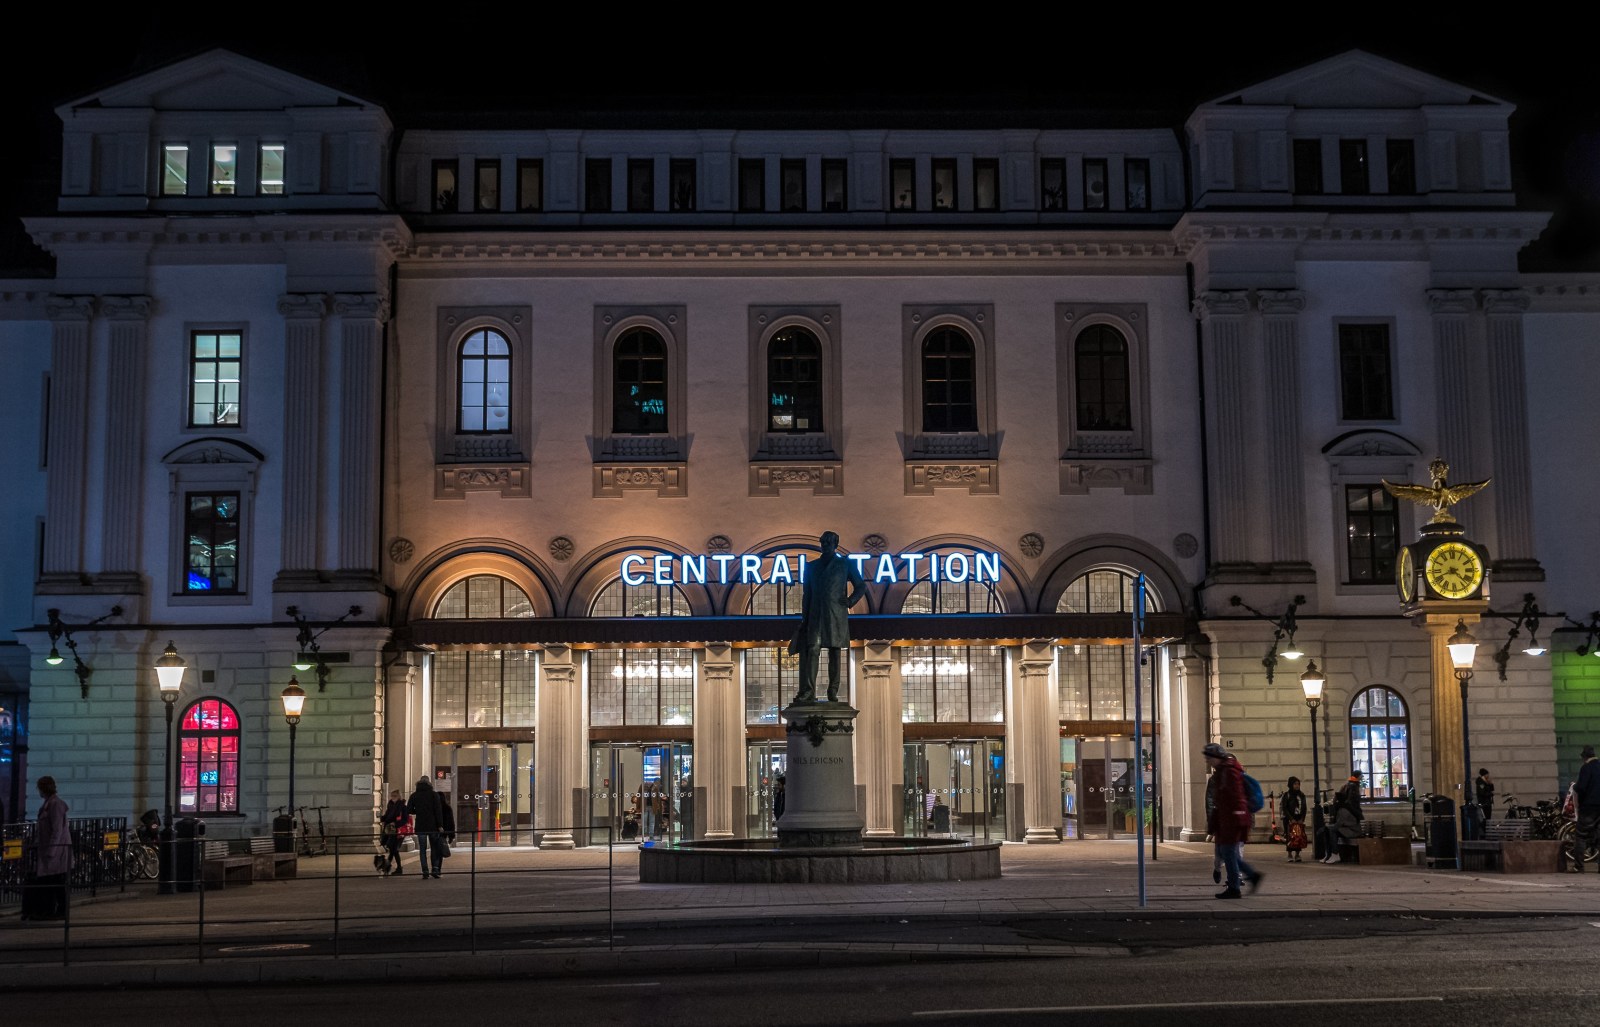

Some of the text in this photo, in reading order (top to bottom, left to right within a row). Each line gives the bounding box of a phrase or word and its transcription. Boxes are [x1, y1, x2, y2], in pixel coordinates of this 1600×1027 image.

[835, 551, 1000, 584] TATION
[1226, 740, 1234, 748] 15
[362, 749, 371, 757] 15
[793, 756, 844, 765] NILS ERICSON
